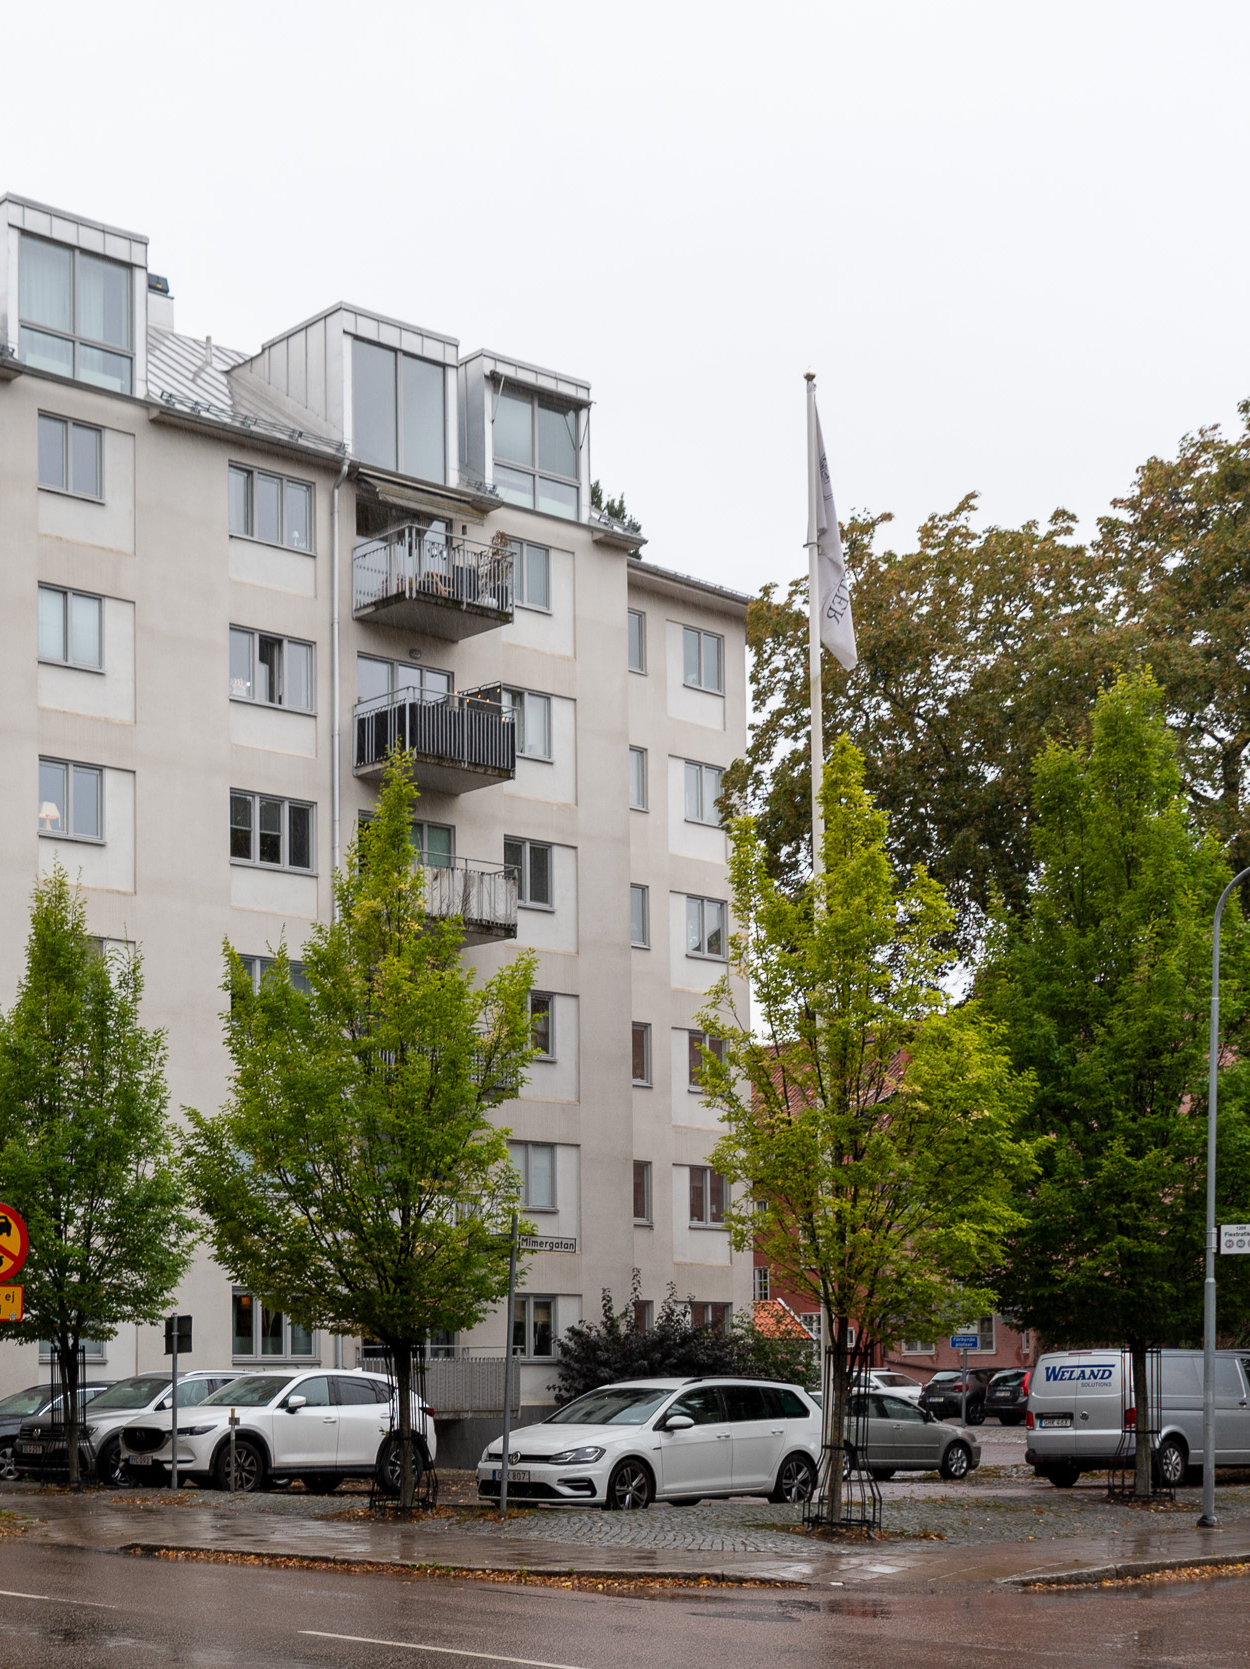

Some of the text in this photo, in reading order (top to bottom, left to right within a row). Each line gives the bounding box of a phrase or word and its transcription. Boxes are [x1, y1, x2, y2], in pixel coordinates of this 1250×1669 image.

[521, 1237, 575, 1250] Mimergatan
[4, 1290, 15, 1304] ej
[1045, 1364, 1116, 1382] WELAND
[512, 1472, 526, 1481] 807
